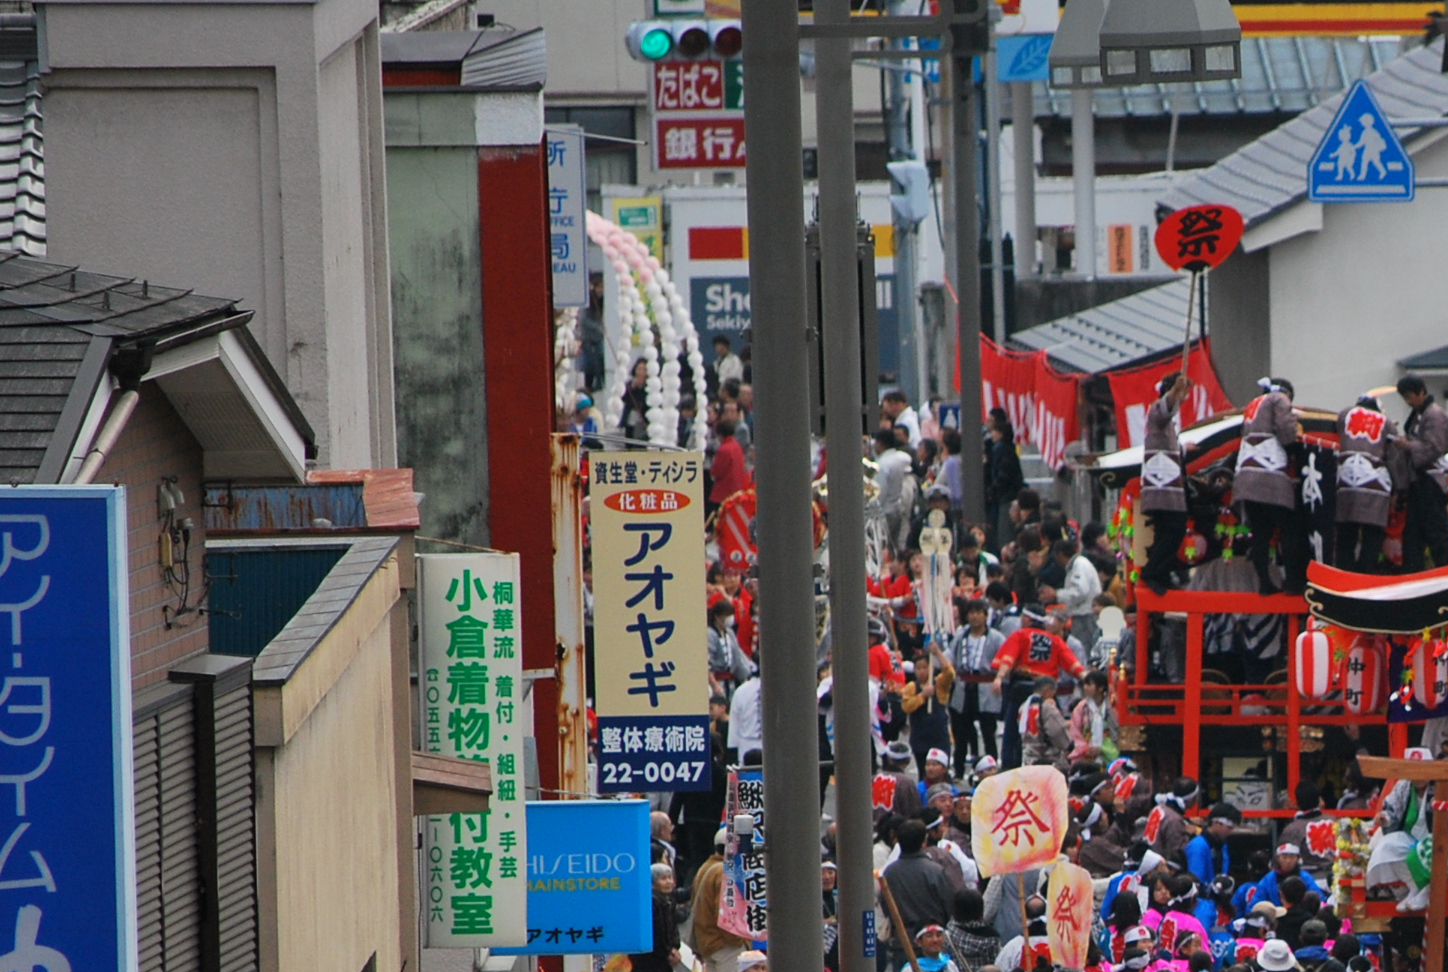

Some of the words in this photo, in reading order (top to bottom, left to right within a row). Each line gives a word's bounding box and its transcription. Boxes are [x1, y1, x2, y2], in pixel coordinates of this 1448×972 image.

[656, 67, 723, 108] たばこ
[1177, 207, 1222, 258] 祭
[552, 263, 576, 274] EAU
[595, 460, 698, 485] 資生堂・ディシラ
[618, 492, 679, 511] 化粧品
[492, 581, 515, 660] 桐華流
[623, 523, 677, 708] アオヤギ
[445, 569, 494, 936] 小倉着物付教室
[602, 725, 706, 754] 整体療術院
[602, 761, 706, 784] 22-0047
[990, 789, 1050, 847] 祭
[526, 851, 636, 875] HISEIDO
[526, 878, 621, 893] HAINSTORE
[1053, 886, 1078, 942] 祭
